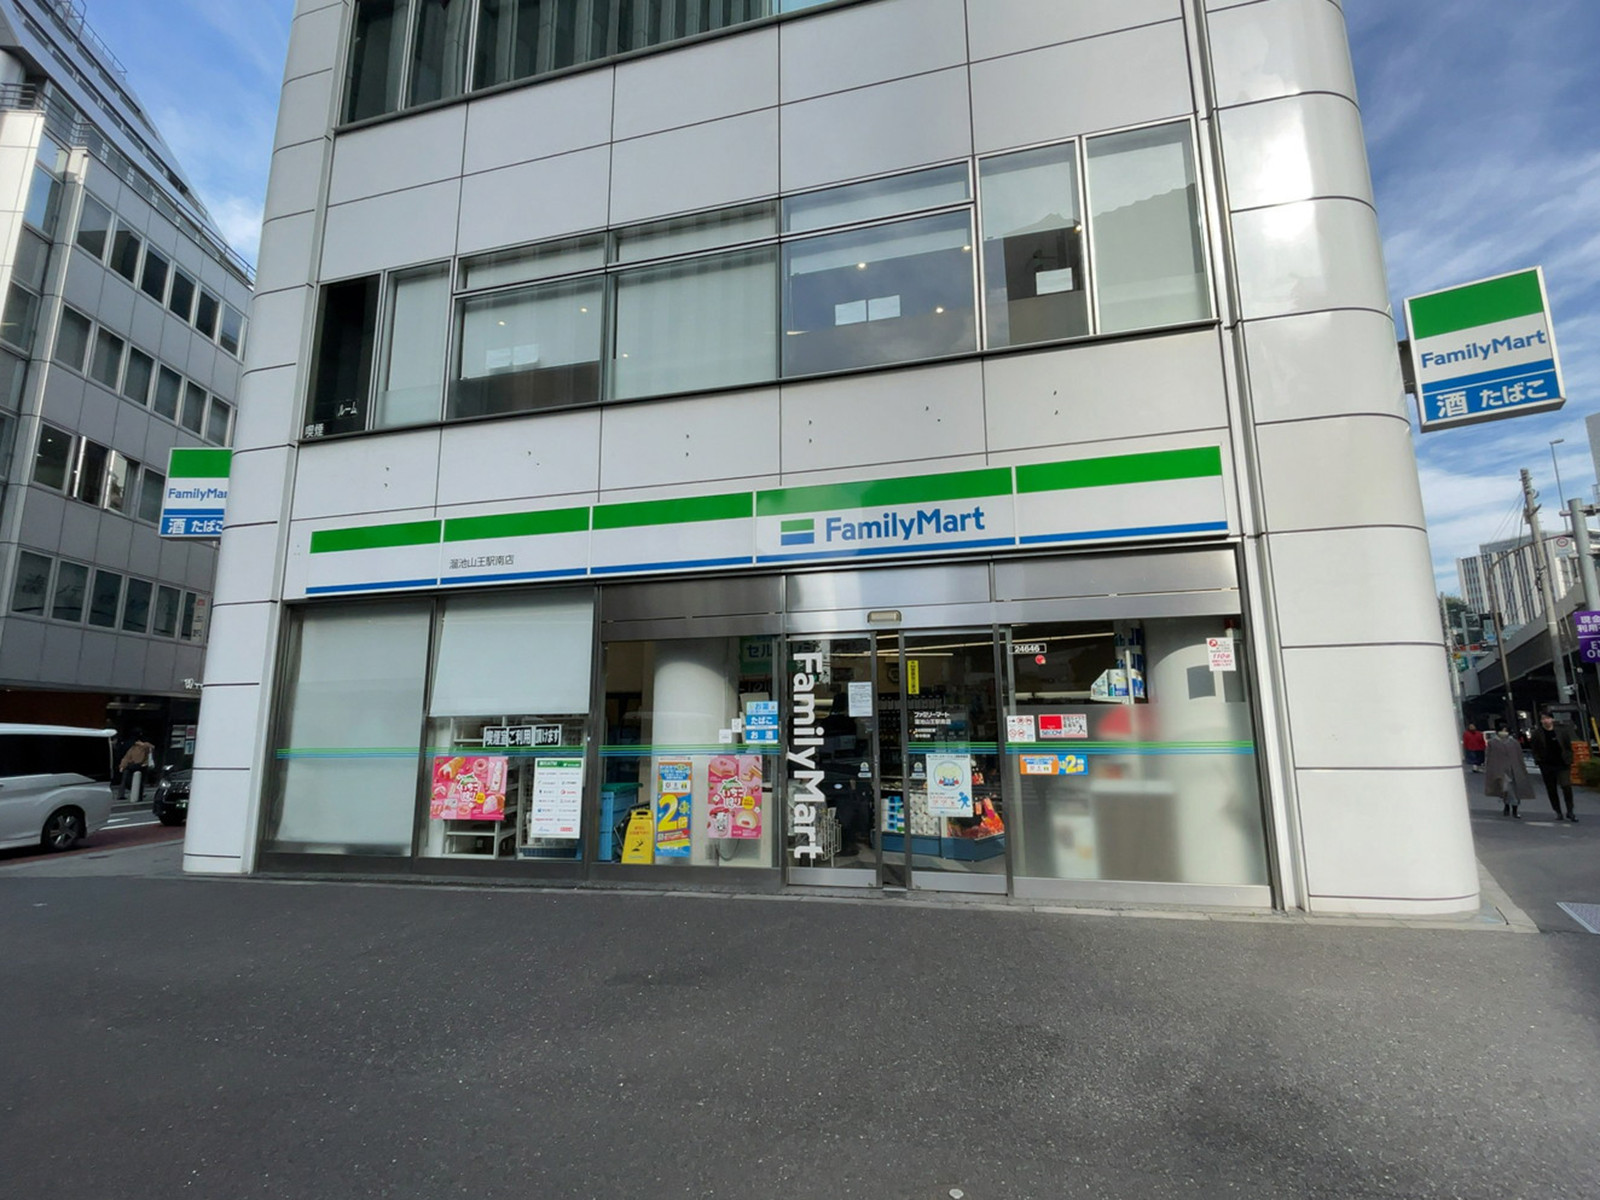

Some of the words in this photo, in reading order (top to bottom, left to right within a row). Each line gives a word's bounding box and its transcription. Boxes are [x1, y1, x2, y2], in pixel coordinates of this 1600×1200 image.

[1421, 329, 1546, 369] FamilyMart
[1435, 390, 1469, 418] 酒
[1480, 379, 1548, 408] たばこ
[337, 401, 358, 417] ルーム
[304, 423, 325, 438] 喫煙
[168, 487, 228, 501] FamilyMar
[167, 518, 187, 534] 酒
[826, 506, 985, 542] FamilyMart
[449, 554, 514, 570] 溜池山王駅南店
[750, 716, 773, 725] たばこ
[786, 652, 826, 860] FamilyMart
